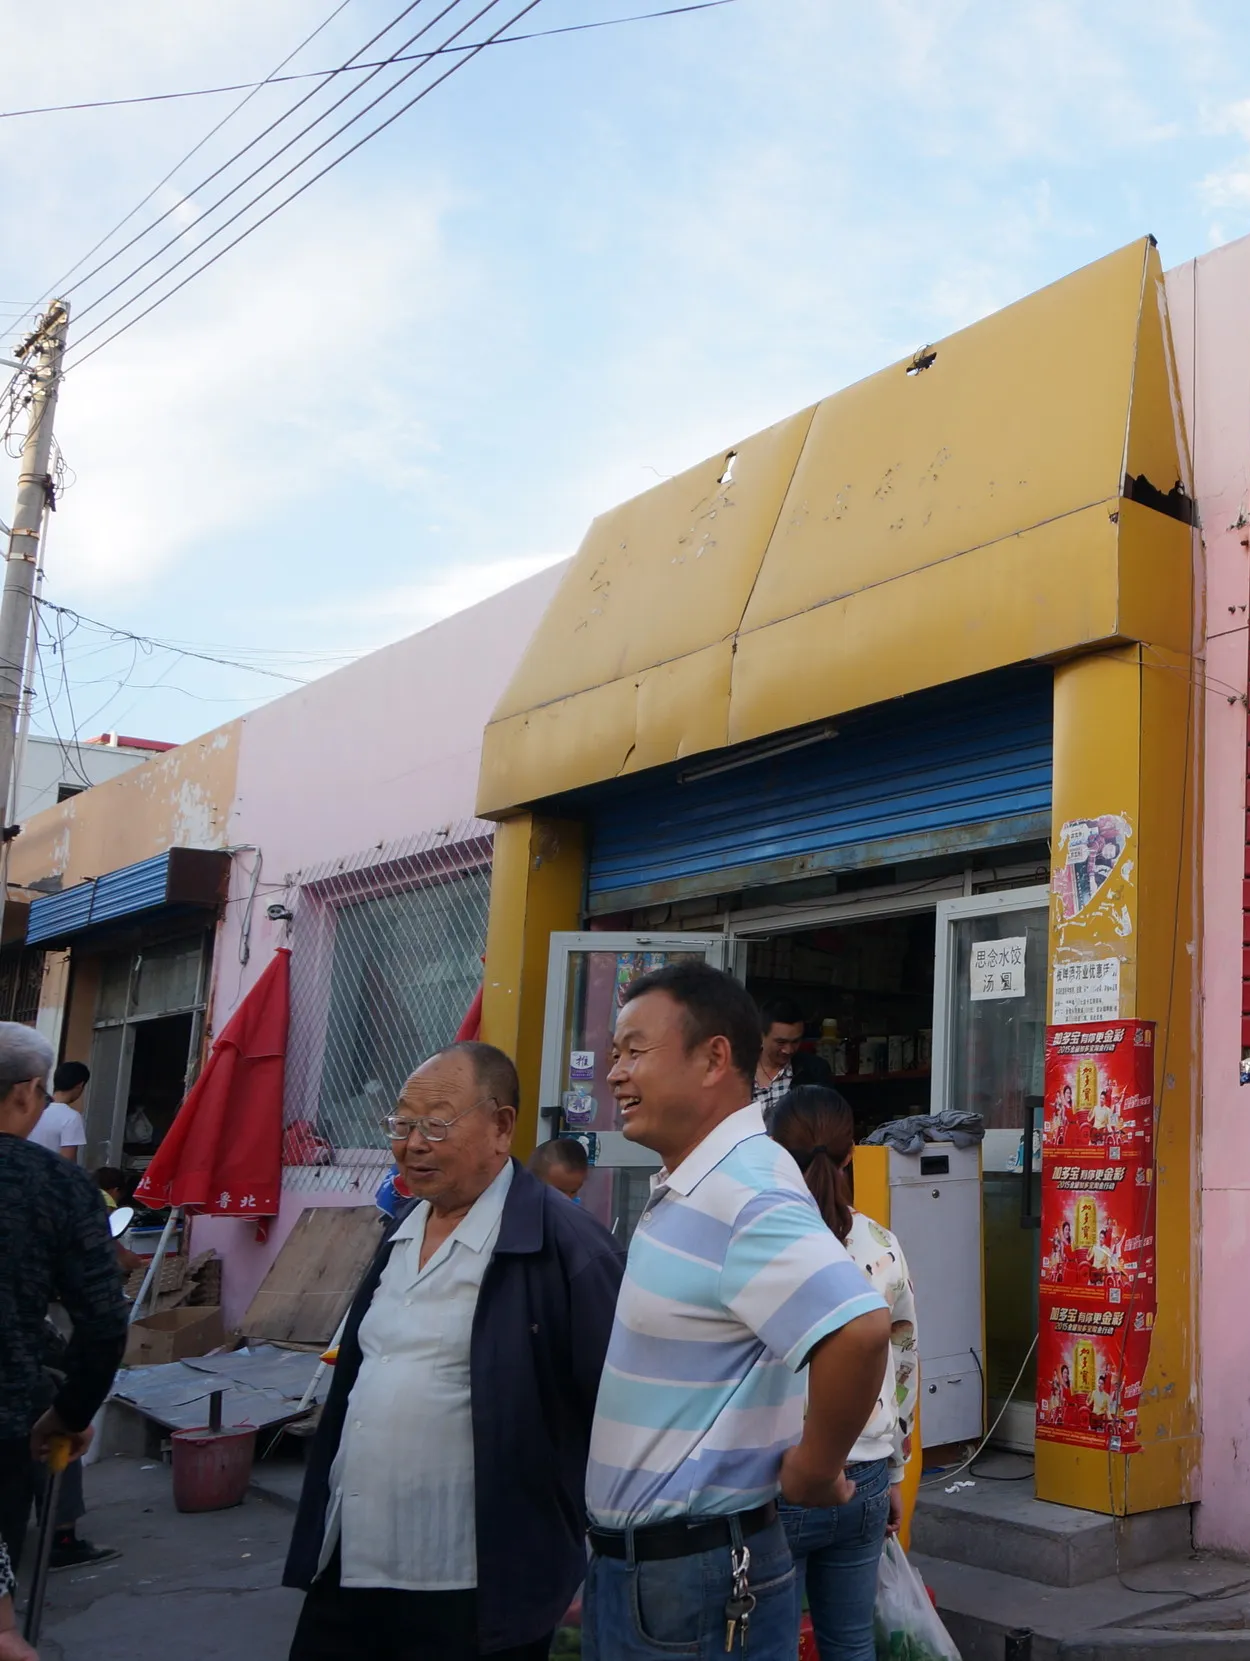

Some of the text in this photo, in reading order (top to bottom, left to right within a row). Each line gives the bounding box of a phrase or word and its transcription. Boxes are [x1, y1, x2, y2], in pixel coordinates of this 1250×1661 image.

[975, 946, 1021, 968] 思念水饺
[216, 1192, 256, 1208] 鲁北
